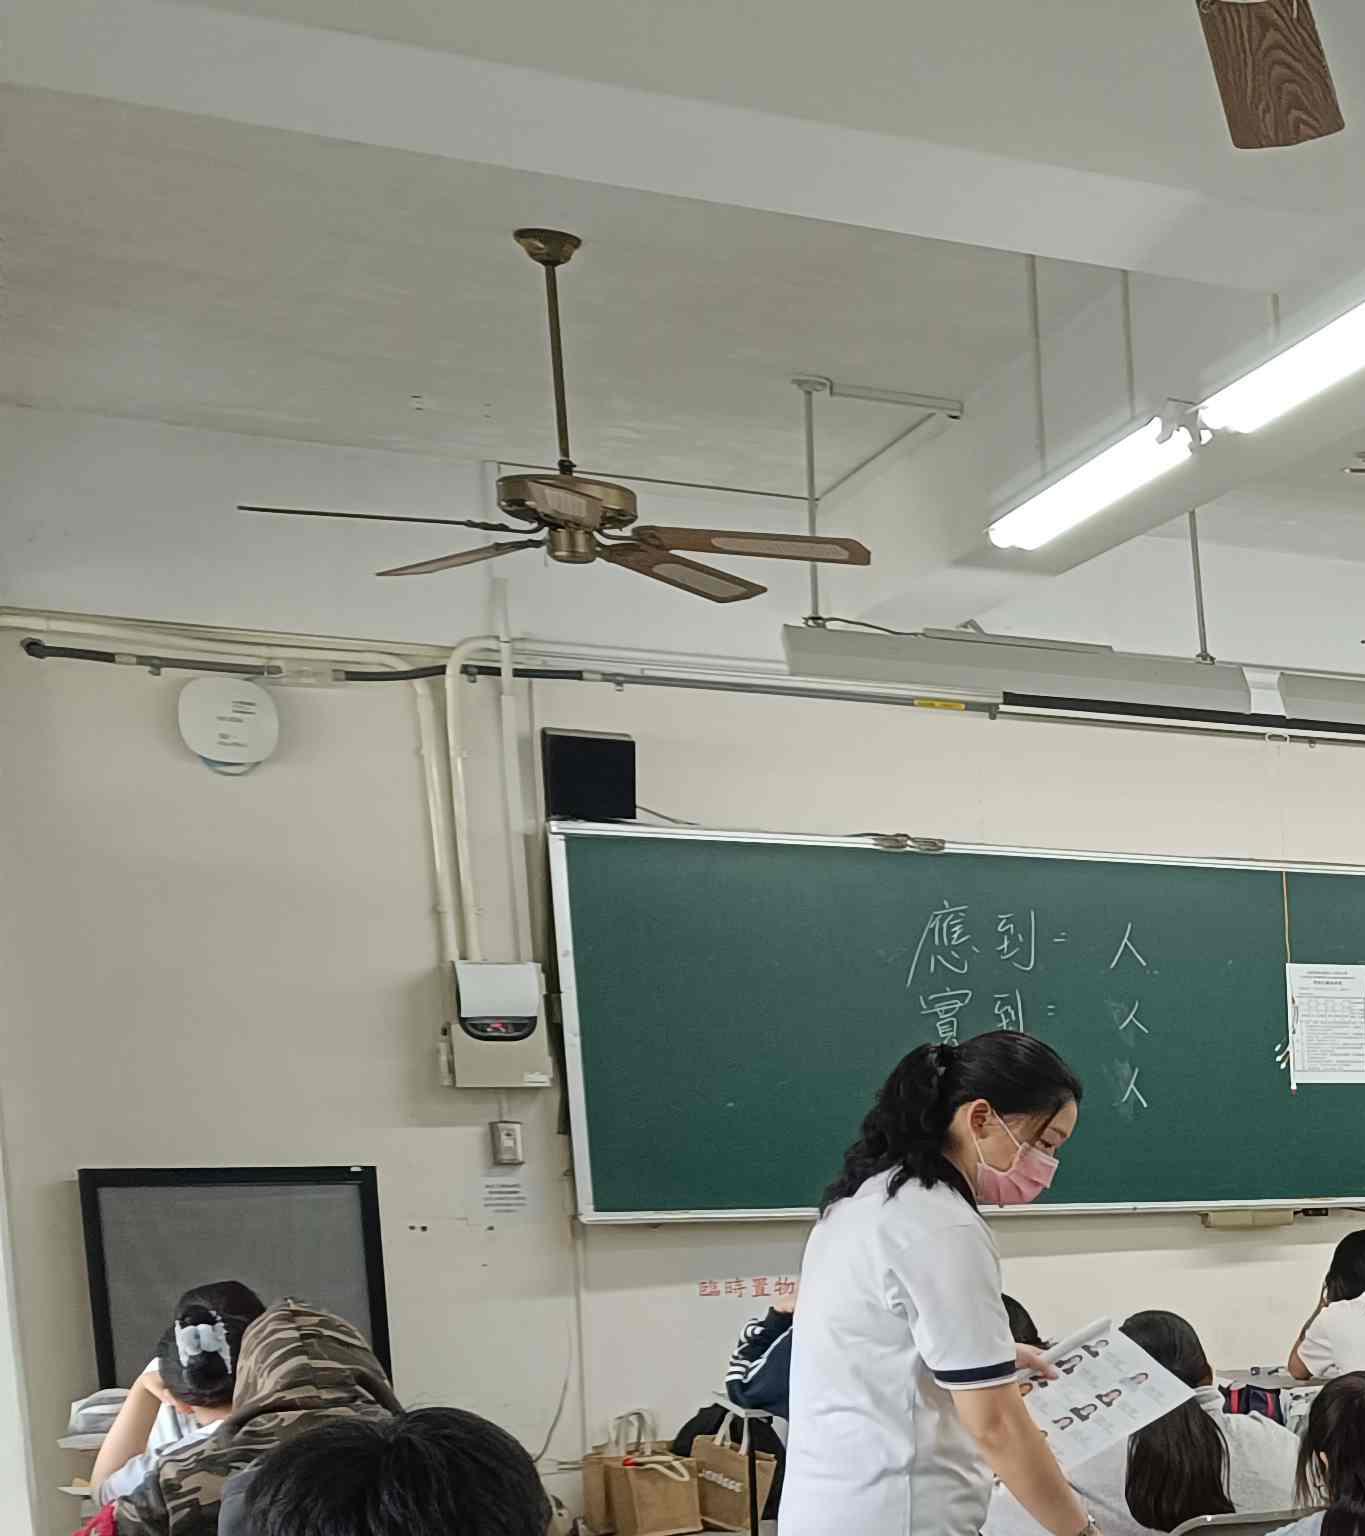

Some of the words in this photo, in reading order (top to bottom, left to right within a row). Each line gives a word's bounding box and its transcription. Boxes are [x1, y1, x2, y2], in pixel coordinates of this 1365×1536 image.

[1110, 921, 1147, 969] 人
[1118, 1000, 1149, 1034] 人
[1121, 1067, 1148, 1108] 人
